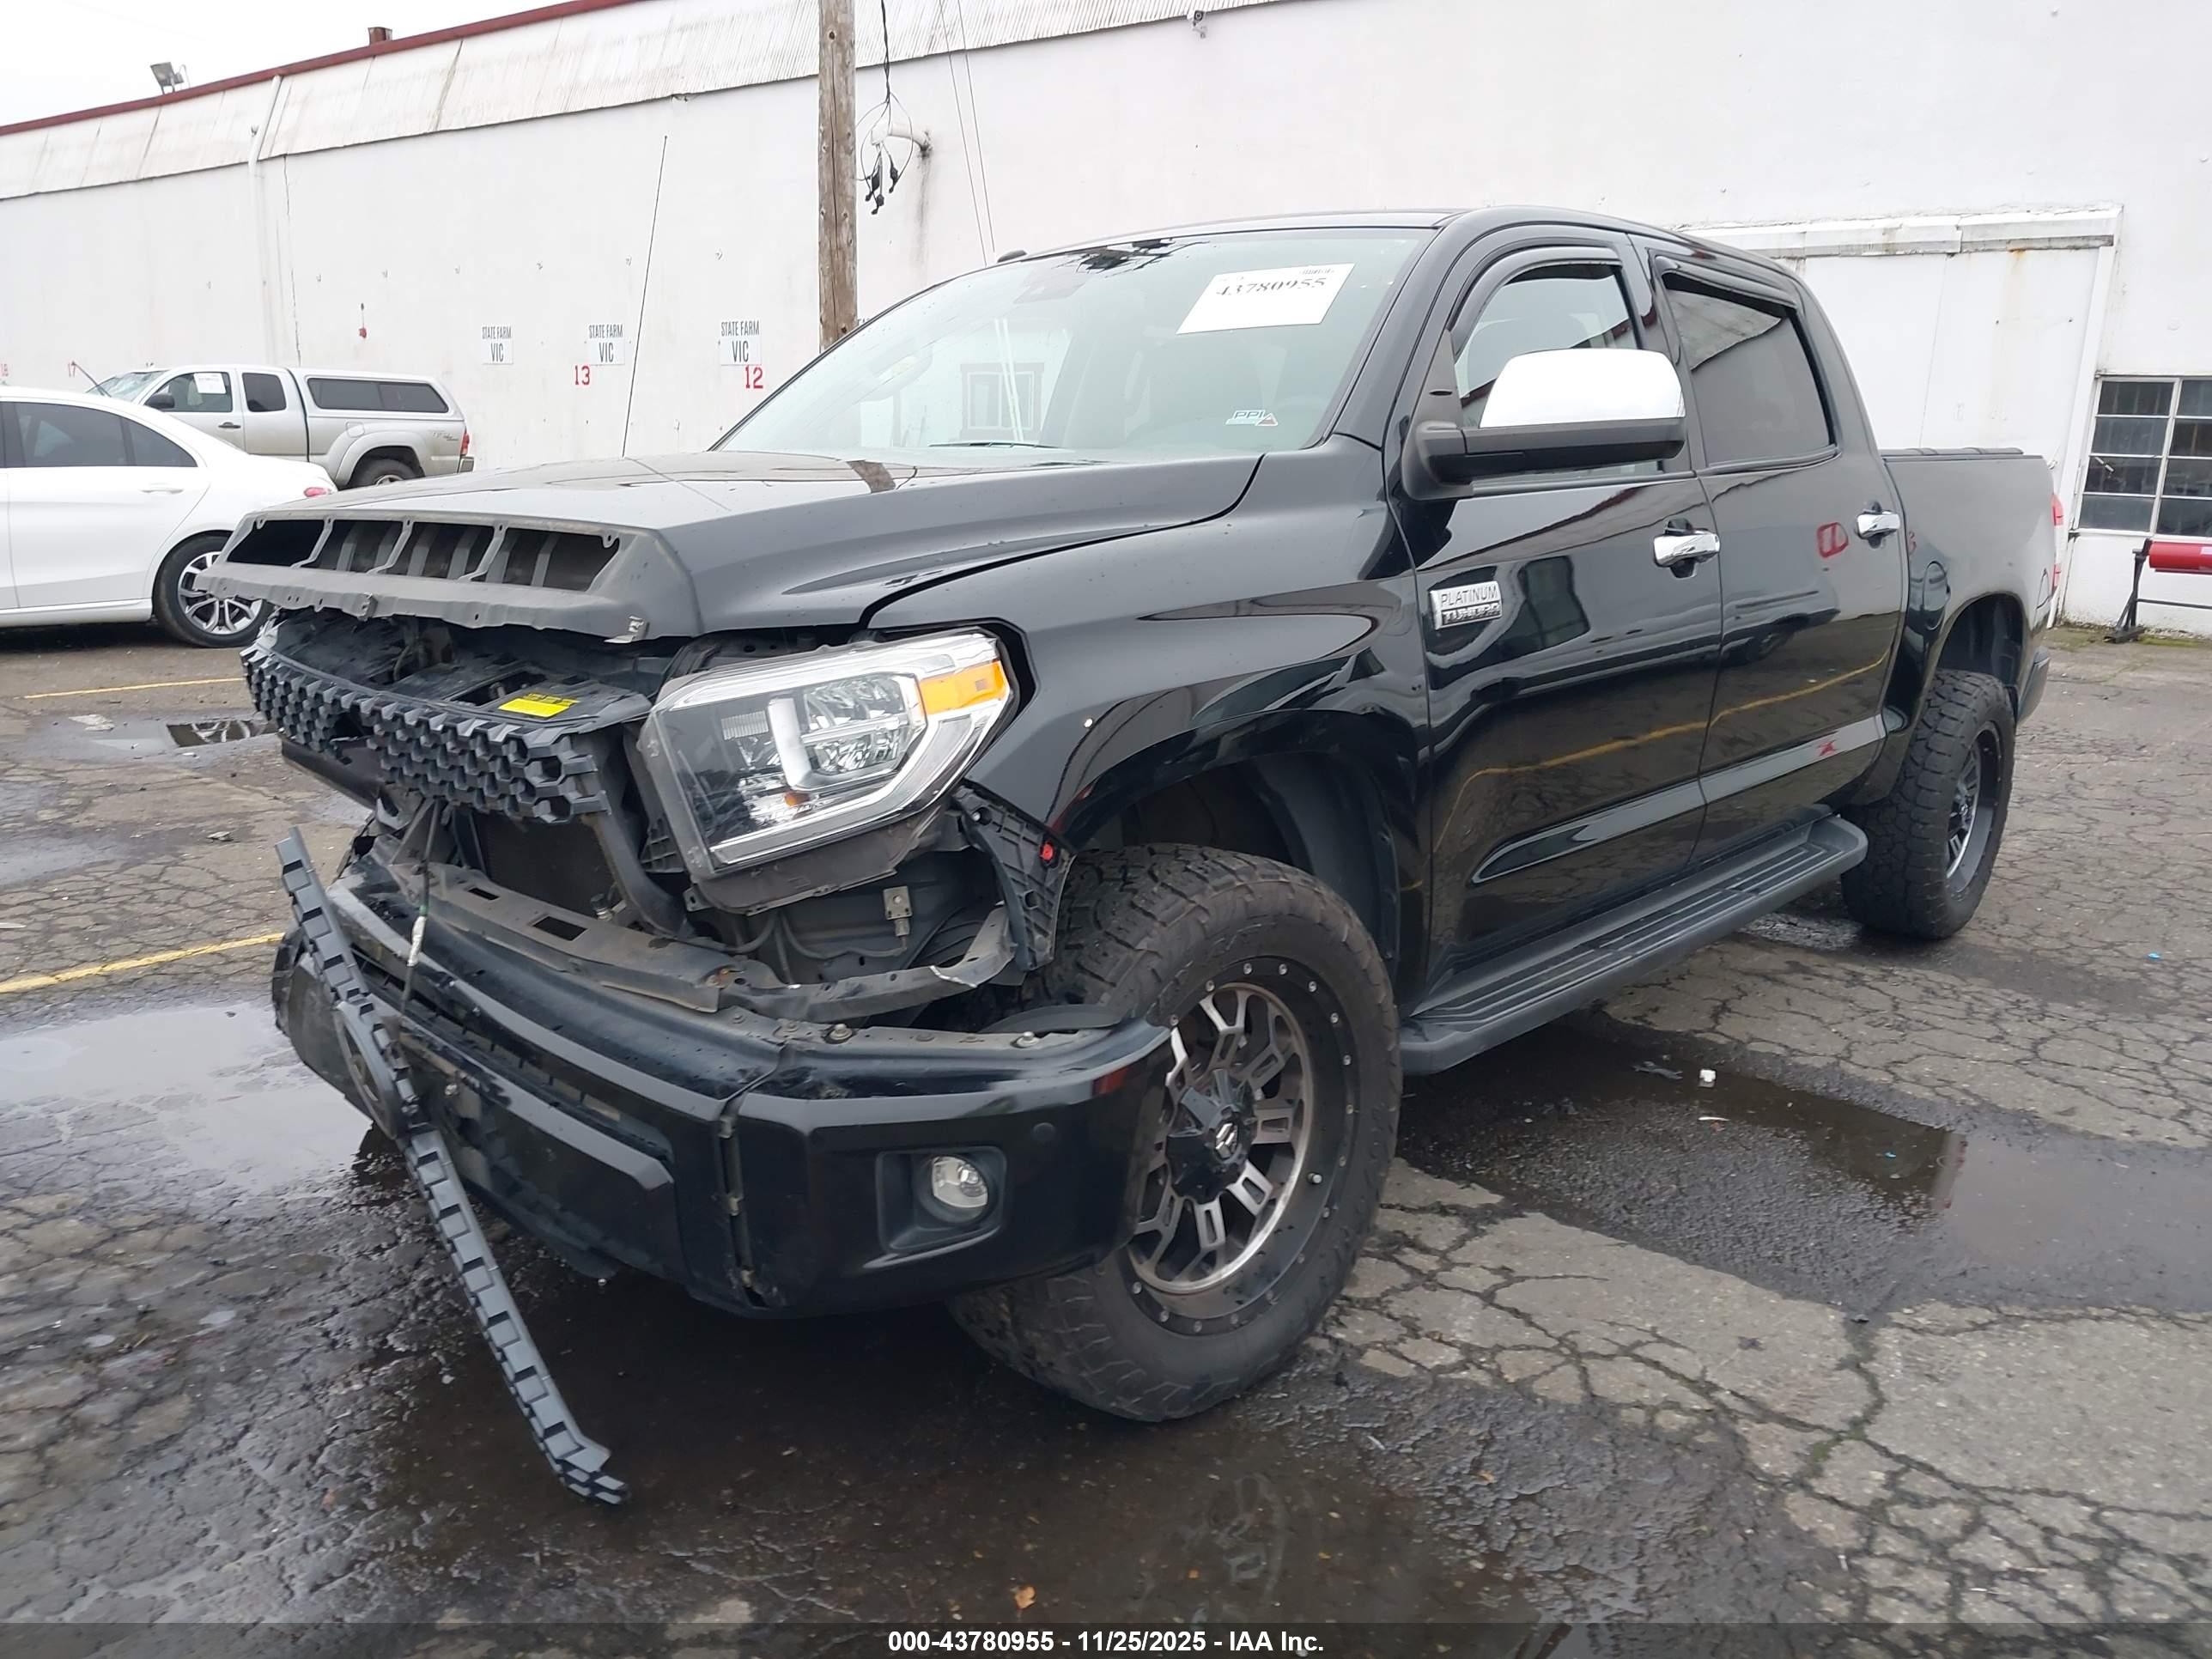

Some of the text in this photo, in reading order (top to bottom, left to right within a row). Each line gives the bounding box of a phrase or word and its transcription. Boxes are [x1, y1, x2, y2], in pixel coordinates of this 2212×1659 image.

[1216, 277, 1327, 295] 43780955
[482, 326, 495, 339] STATE
[588, 324, 623, 338] STATE FARM
[720, 319, 759, 337] STATE FARM
[490, 343, 504, 362] VIC
[599, 342, 614, 362] VIC
[732, 340, 749, 362] VIC
[574, 365, 590, 386] 13
[744, 365, 763, 389] 12
[1441, 585, 1498, 605] PLATINUM
